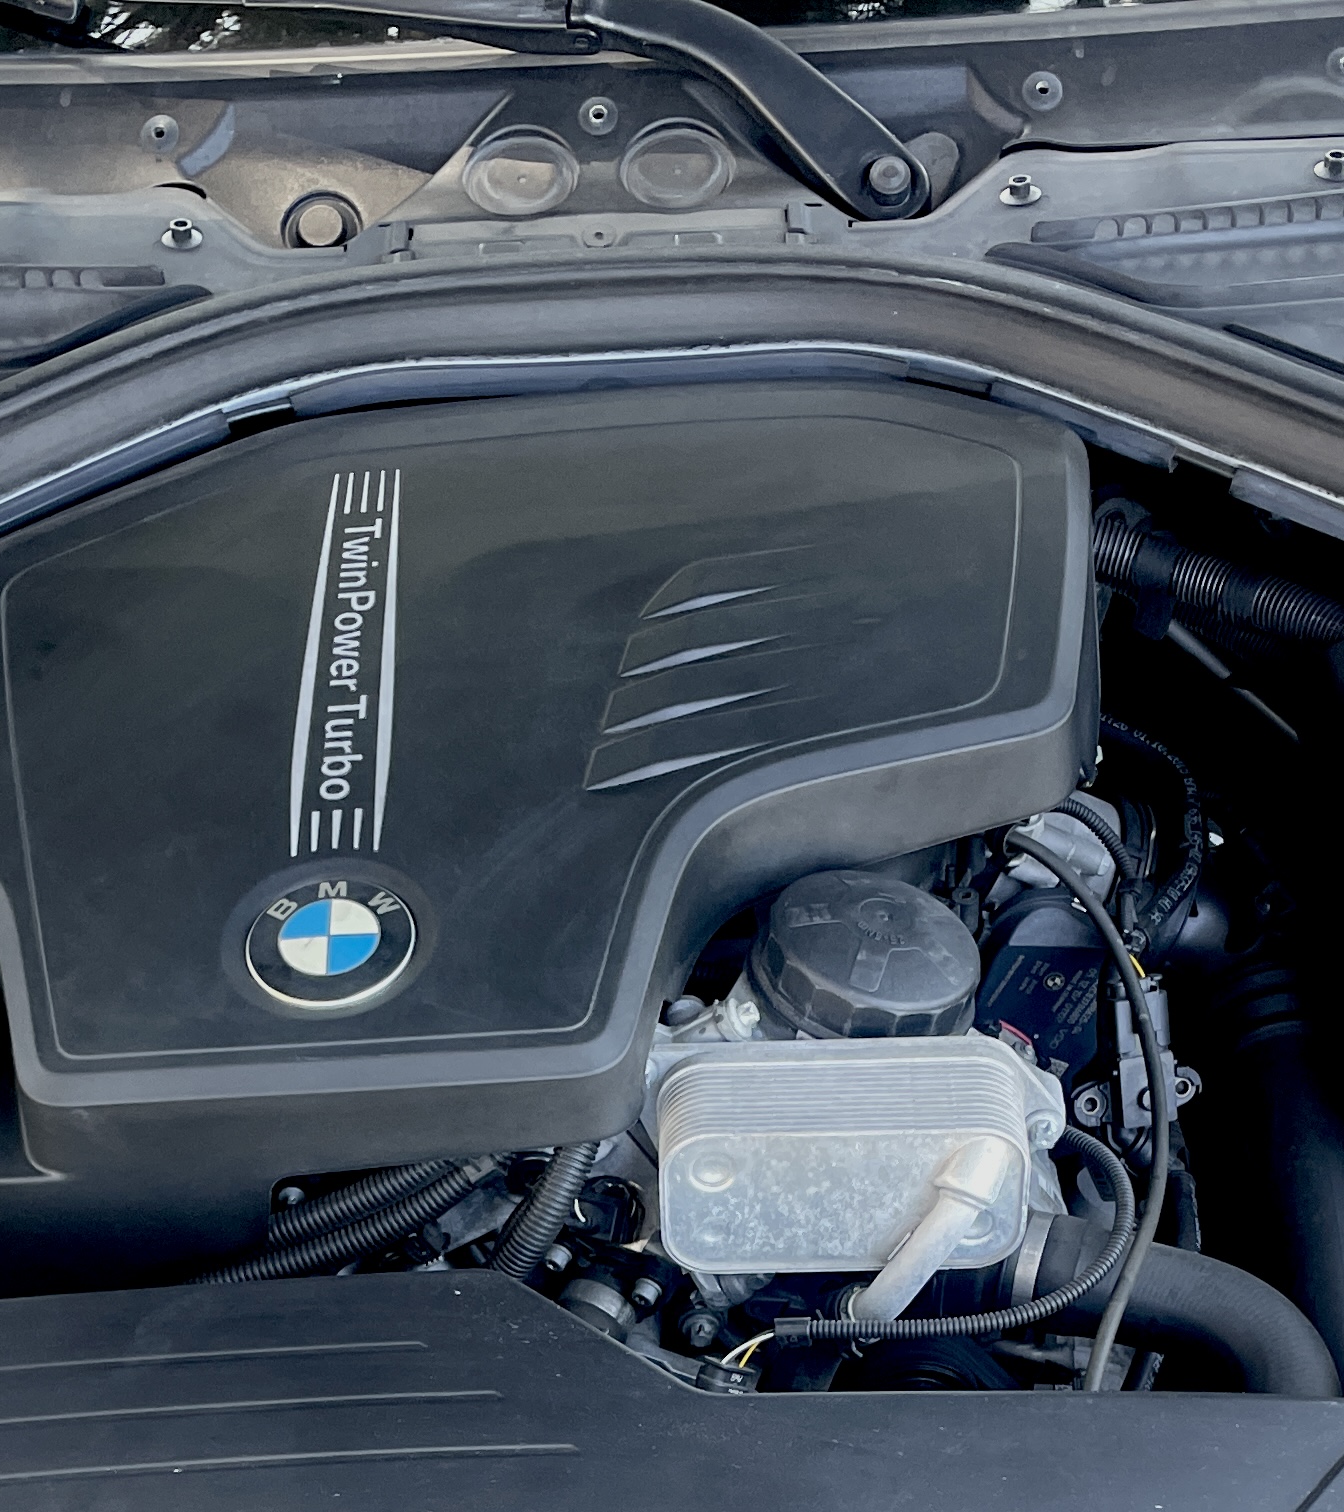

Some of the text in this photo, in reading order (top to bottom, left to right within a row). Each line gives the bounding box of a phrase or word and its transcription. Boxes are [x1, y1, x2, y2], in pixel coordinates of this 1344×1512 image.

[319, 517, 383, 800] TwinPower Turbo
[267, 879, 401, 921] BMW
